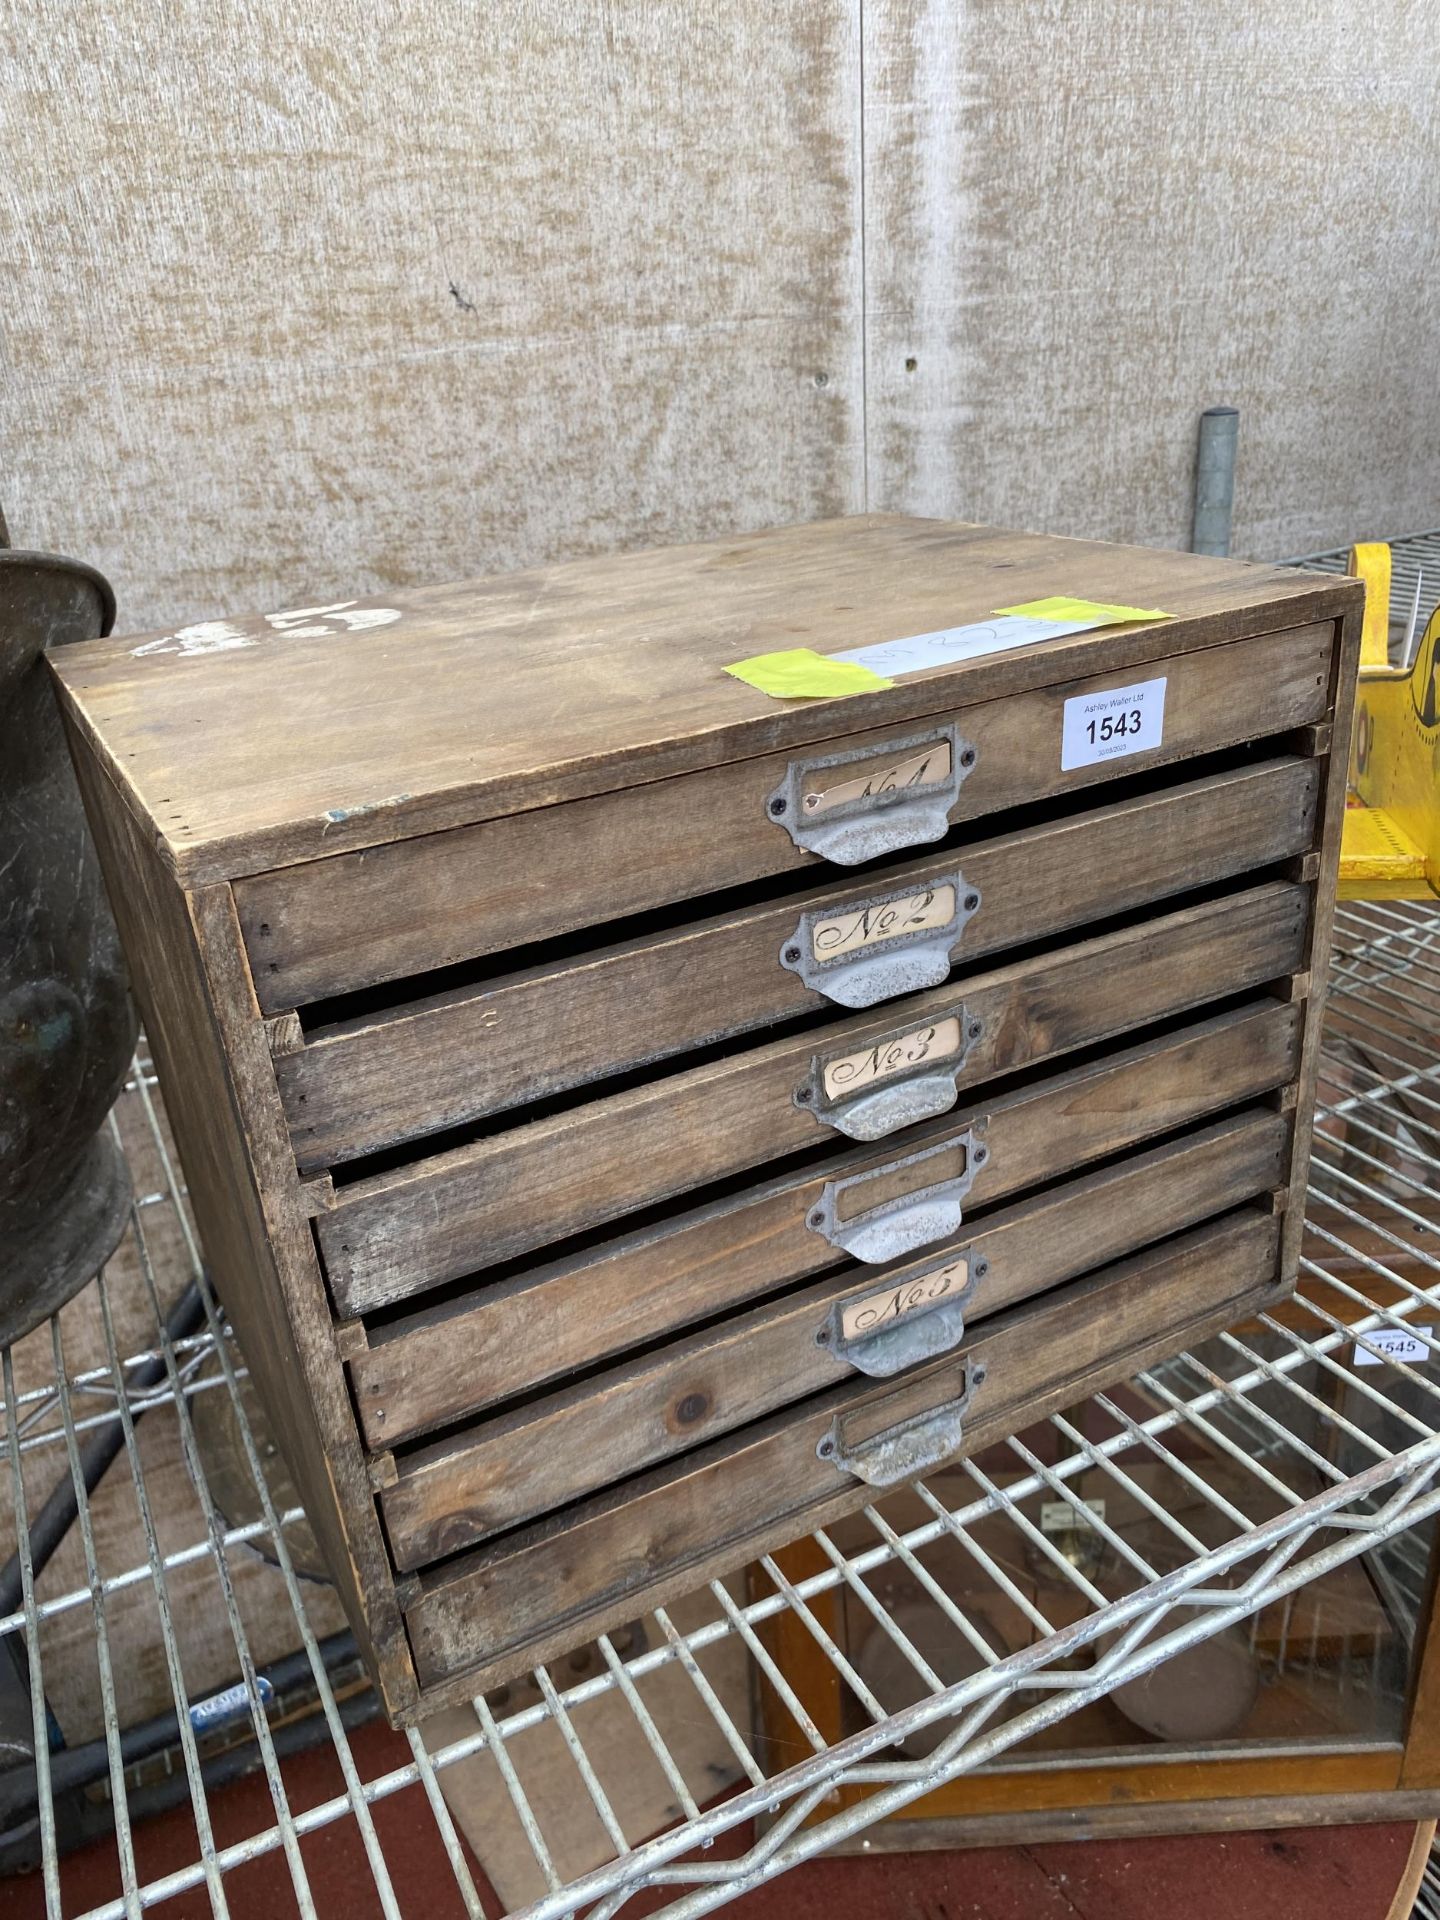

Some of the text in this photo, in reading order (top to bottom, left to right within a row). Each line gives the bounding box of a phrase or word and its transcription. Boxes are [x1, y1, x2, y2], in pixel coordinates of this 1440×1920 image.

[1084, 702, 1108, 714] Ashley
[1133, 693, 1144, 703] Ltd
[1086, 709, 1142, 745] 1543
